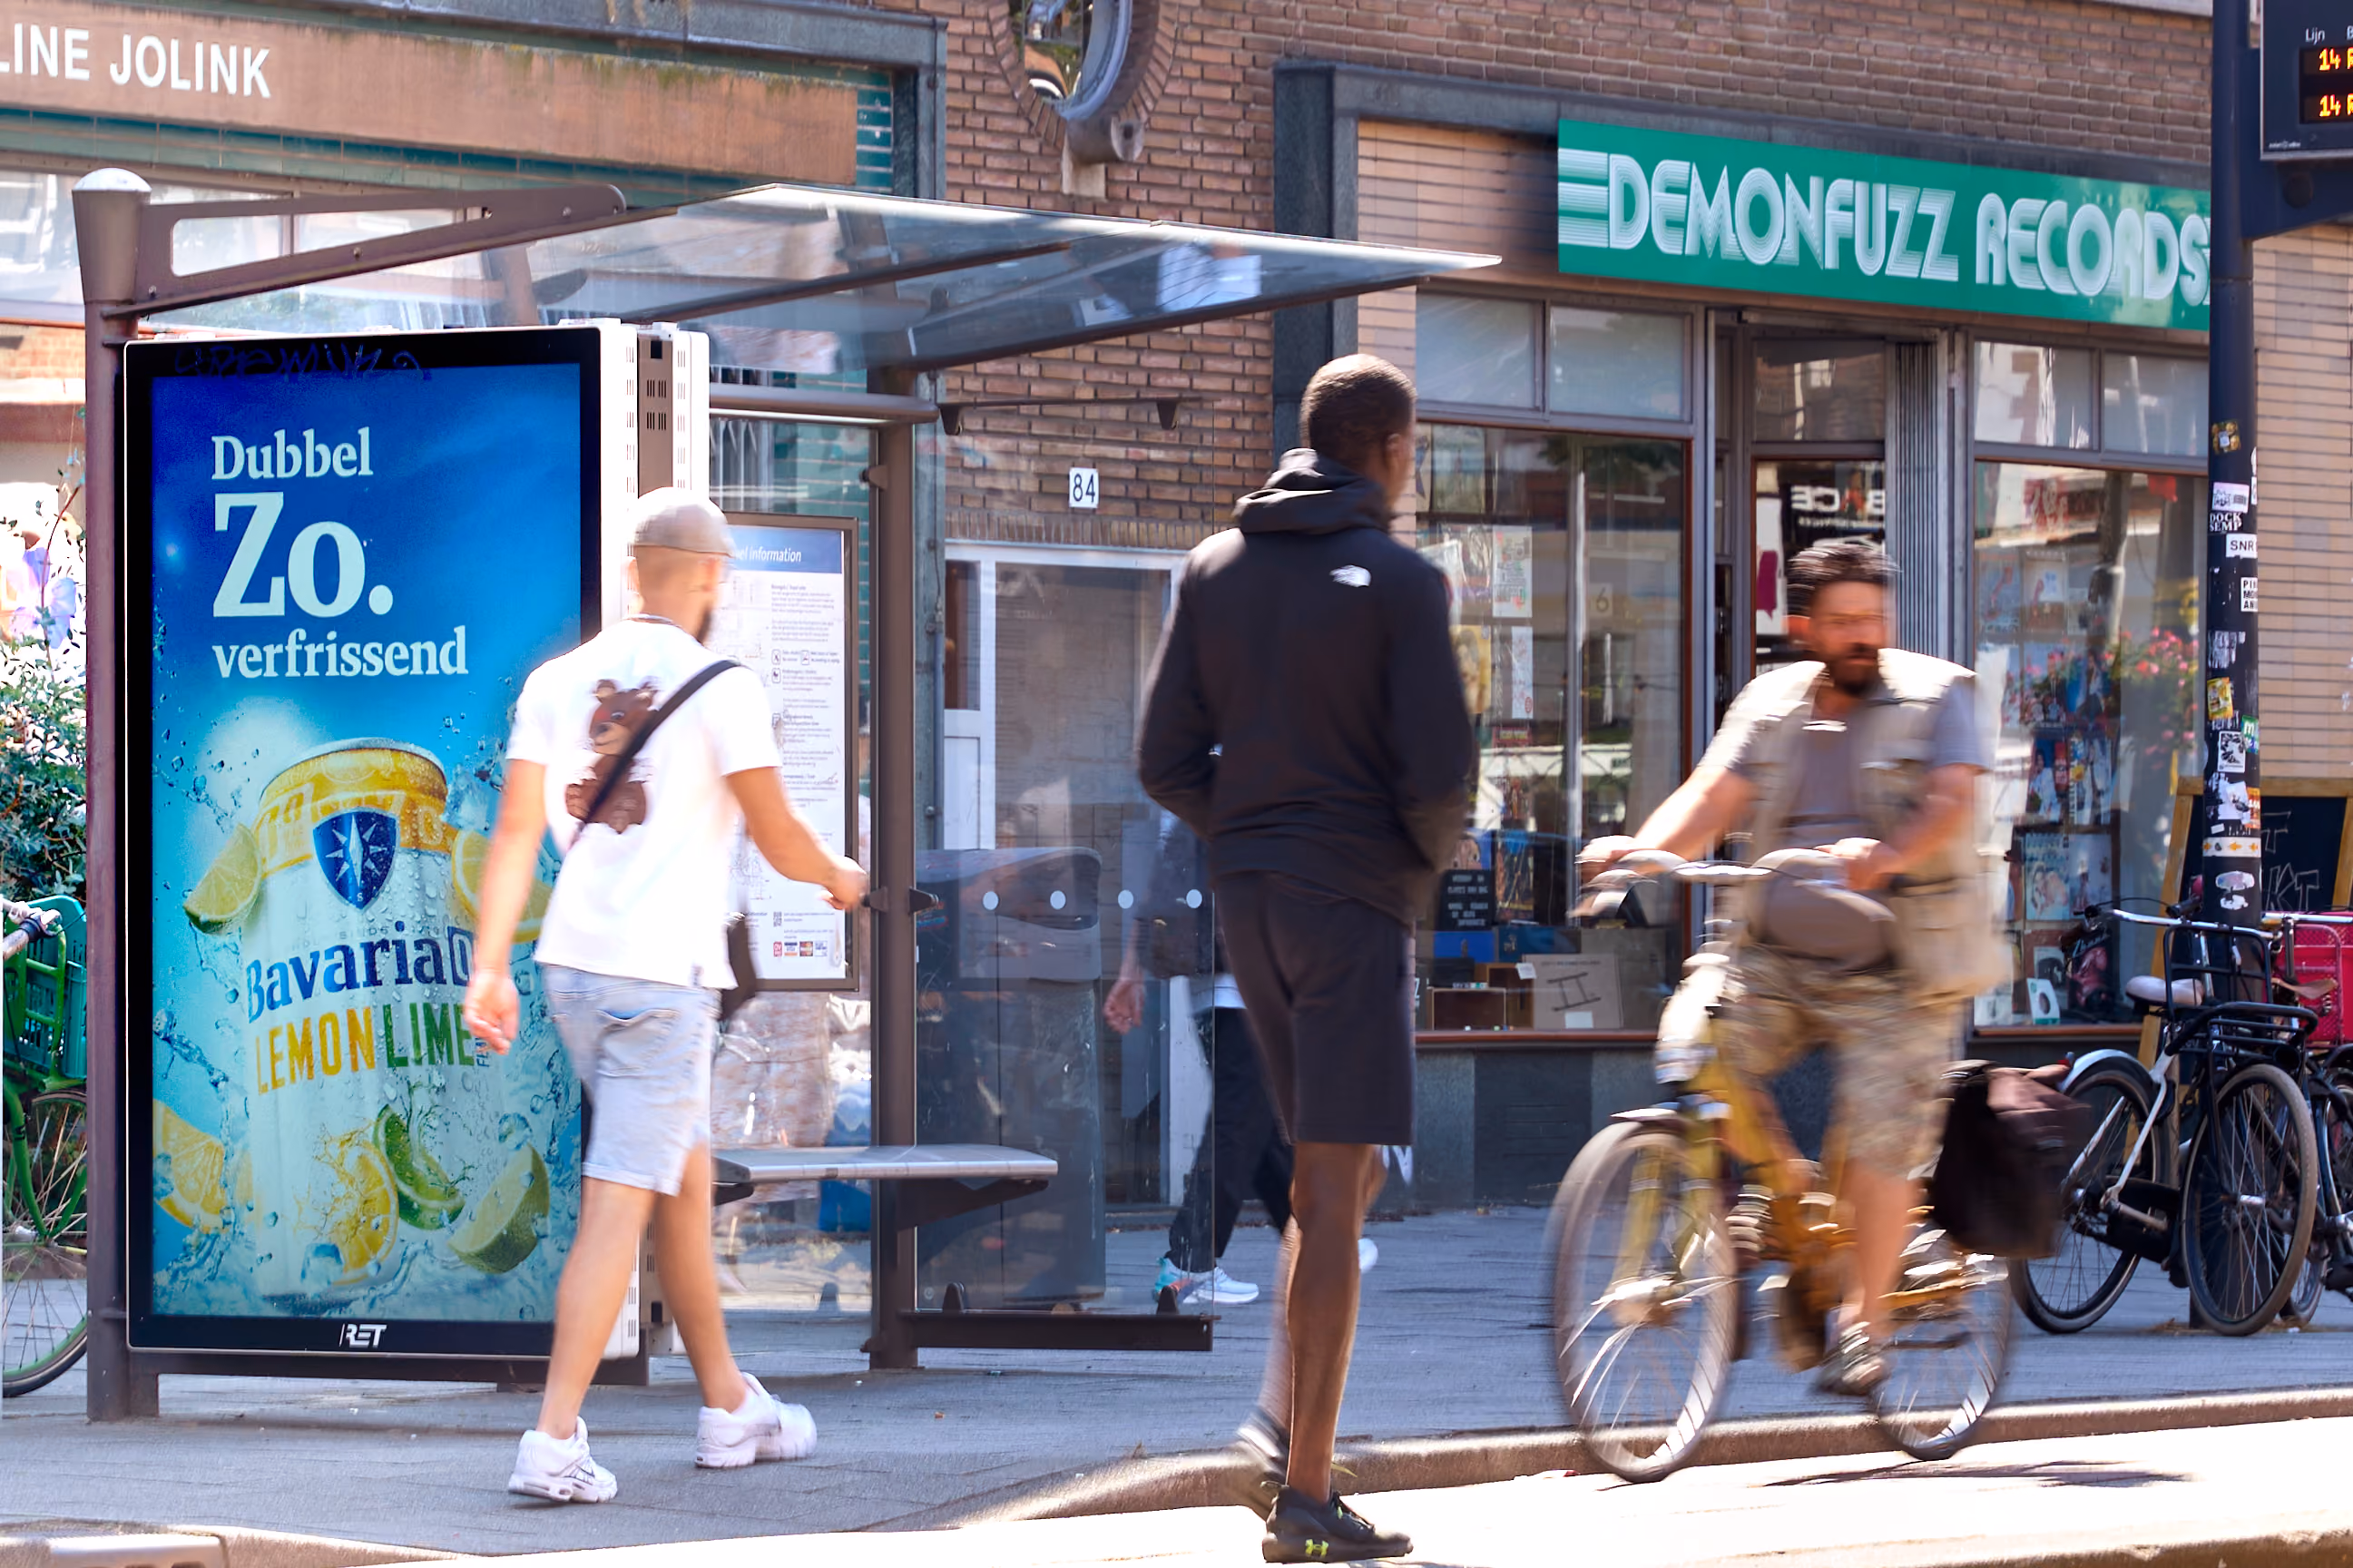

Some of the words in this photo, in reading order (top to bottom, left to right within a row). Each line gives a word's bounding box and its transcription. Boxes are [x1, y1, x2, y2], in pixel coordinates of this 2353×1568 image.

[2305, 28, 2326, 44] Lijn
[2319, 48, 2341, 71] 14
[110, 34, 271, 98] JOLINK
[2319, 94, 2341, 117] 14
[1558, 147, 1958, 281] DEMONFUZZ
[1976, 192, 2211, 307] RECORDS
[211, 426, 373, 480] Dubbel
[1074, 474, 1095, 503] 84
[213, 492, 393, 618] Zo.
[750, 545, 802, 563] Information
[211, 625, 469, 678] verfrissend
[246, 921, 447, 1024] Bavaria
[256, 1006, 376, 1096] LEMON
[383, 1003, 475, 1068] LIME
[344, 1323, 387, 1348] RET
